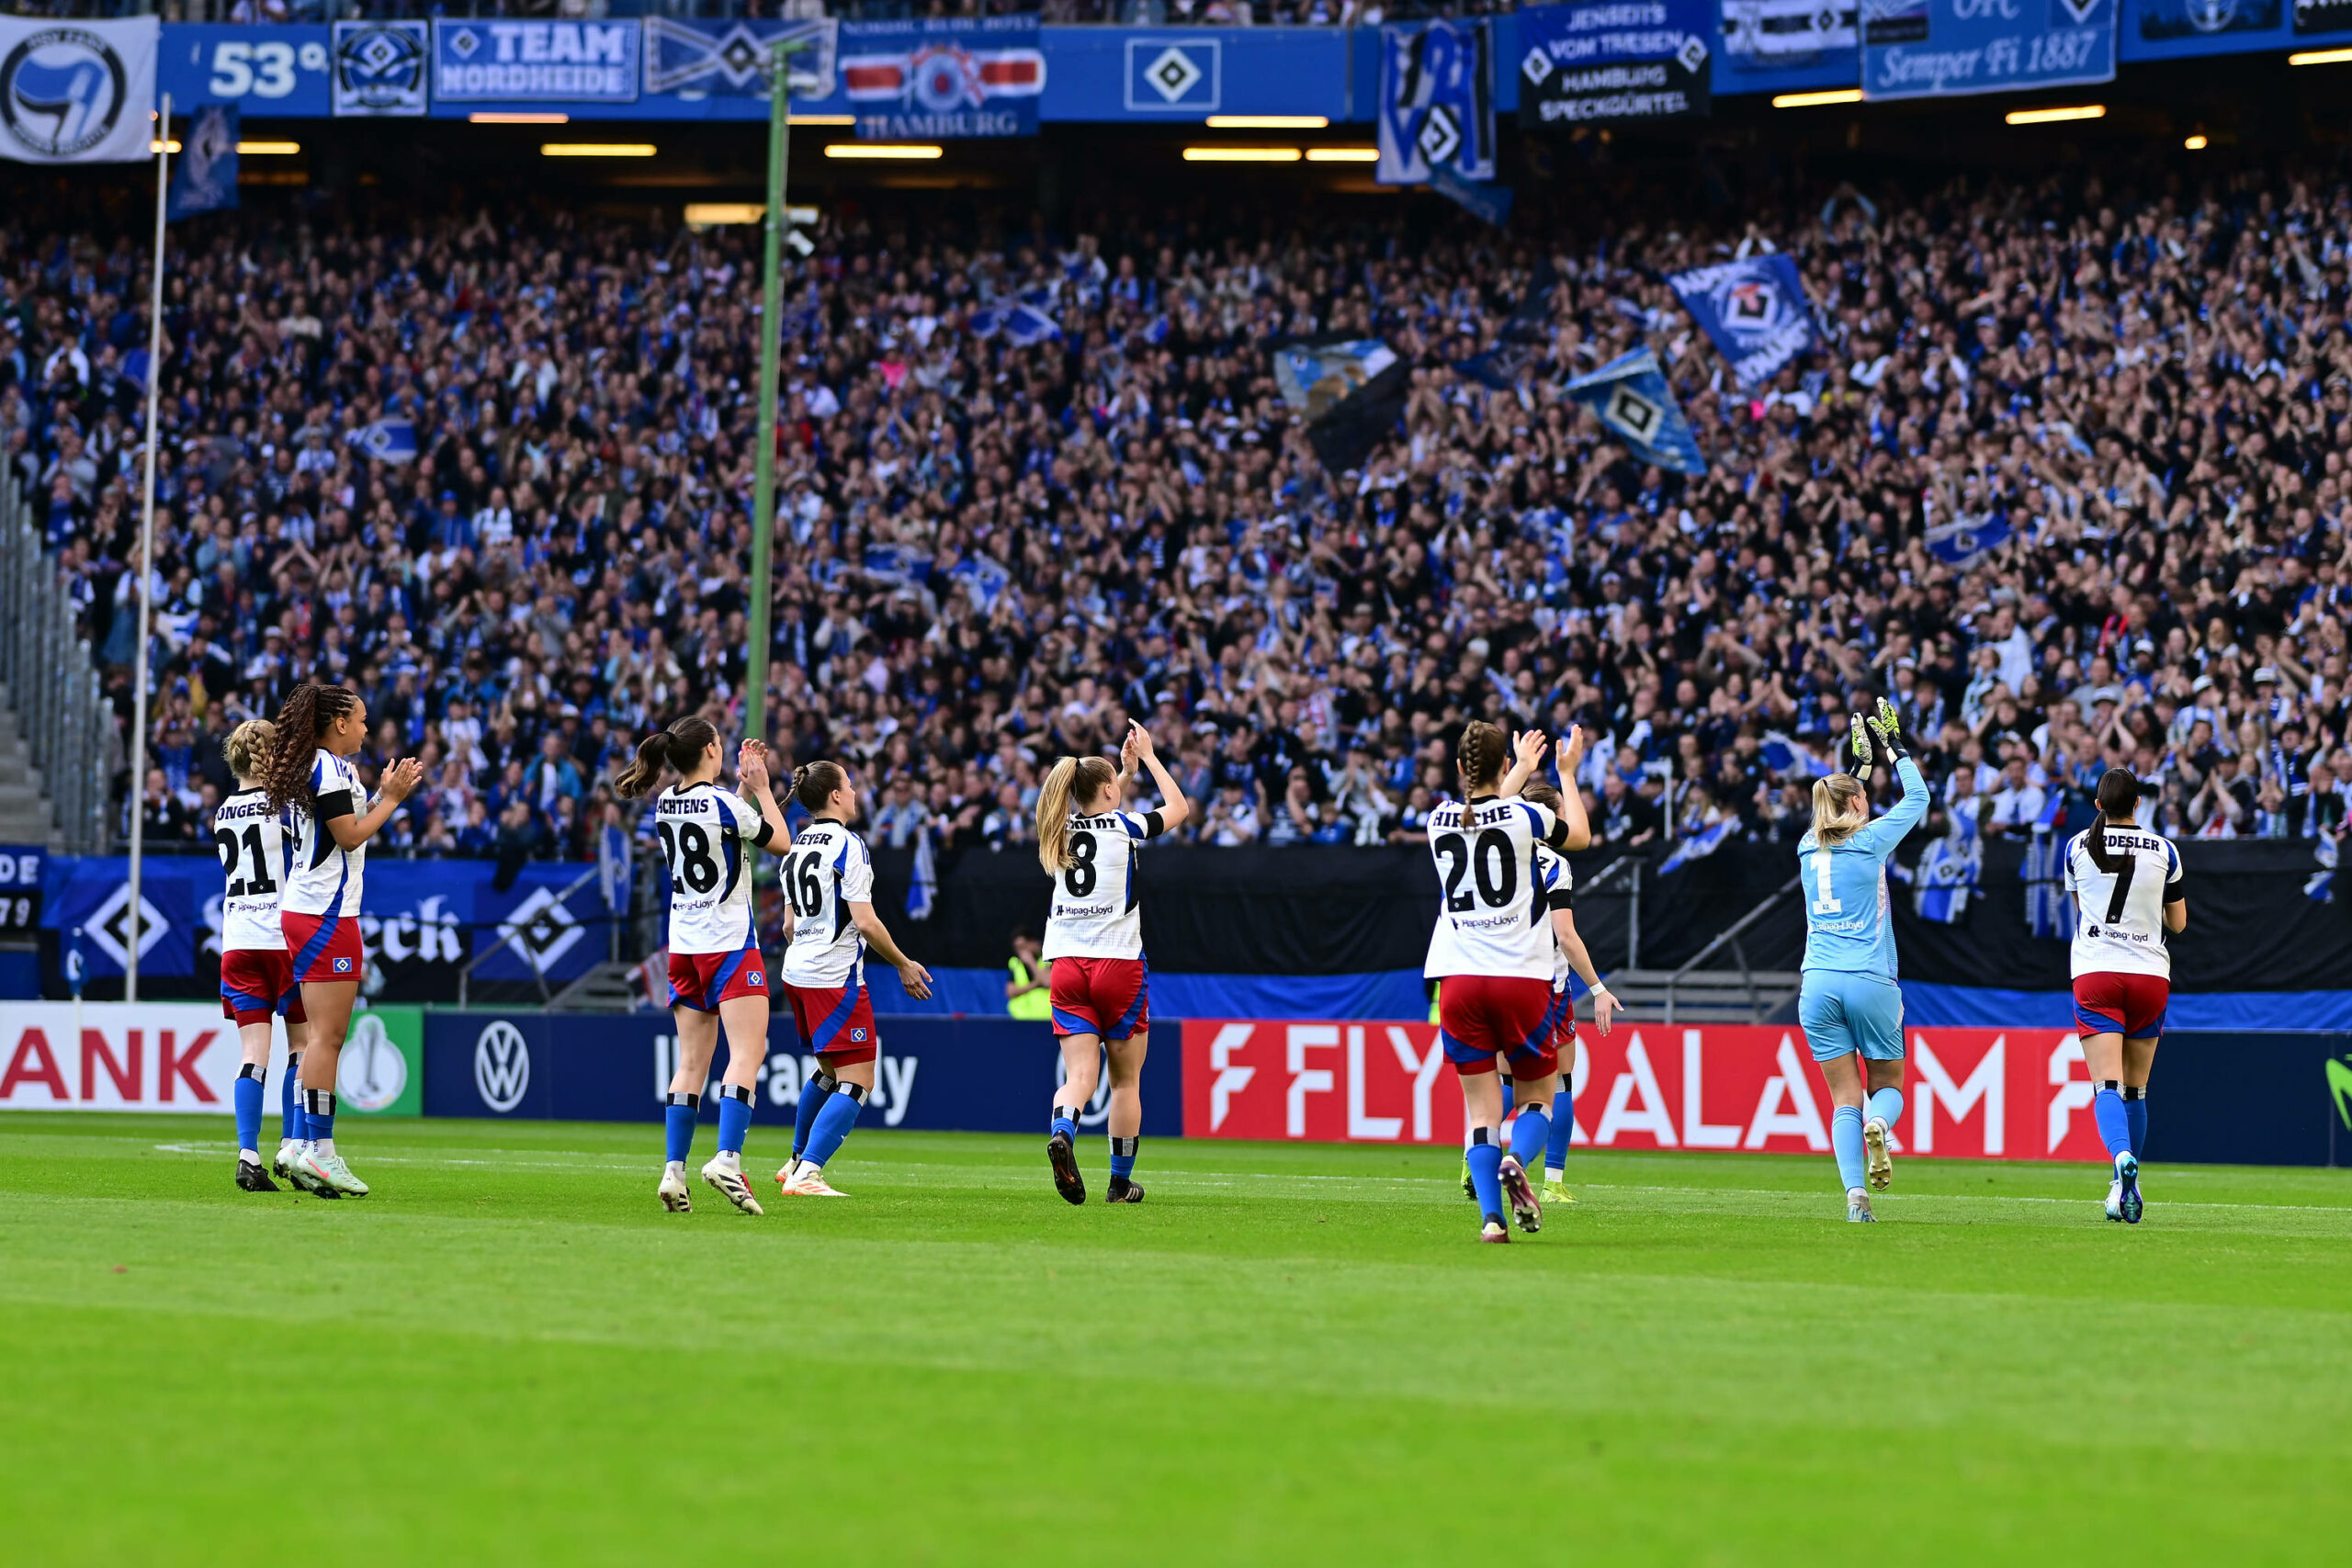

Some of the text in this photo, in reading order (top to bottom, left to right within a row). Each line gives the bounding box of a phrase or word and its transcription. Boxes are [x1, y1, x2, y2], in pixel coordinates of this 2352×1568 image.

[1566, 4, 1667, 31] JENSEITS
[490, 23, 626, 62] TEAM
[1548, 30, 1683, 59] VOM TRESEN
[1877, 30, 2098, 91] Semper Fi 1887
[441, 63, 625, 93] NORDHEIDE
[1563, 65, 1667, 92] HAMBURG
[1540, 91, 1688, 121] SPECKGÜRTEL
[865, 111, 1017, 139] HAMBURG
[217, 802, 267, 820] ONGES
[657, 798, 708, 815] ACHTENS
[1433, 805, 1512, 828] HIRHE
[657, 821, 718, 895] 28
[2079, 834, 2160, 852] KDESLER
[215, 823, 277, 897] 21
[1065, 830, 1097, 897] 8
[1435, 828, 1517, 912] 20
[782, 851, 822, 917] 16
[1810, 850, 1842, 915] 1
[2100, 854, 2136, 924] 7
[1462, 915, 1519, 928] Hapag-Lloyd
[1286, 1024, 2005, 1156] FLYALAM
